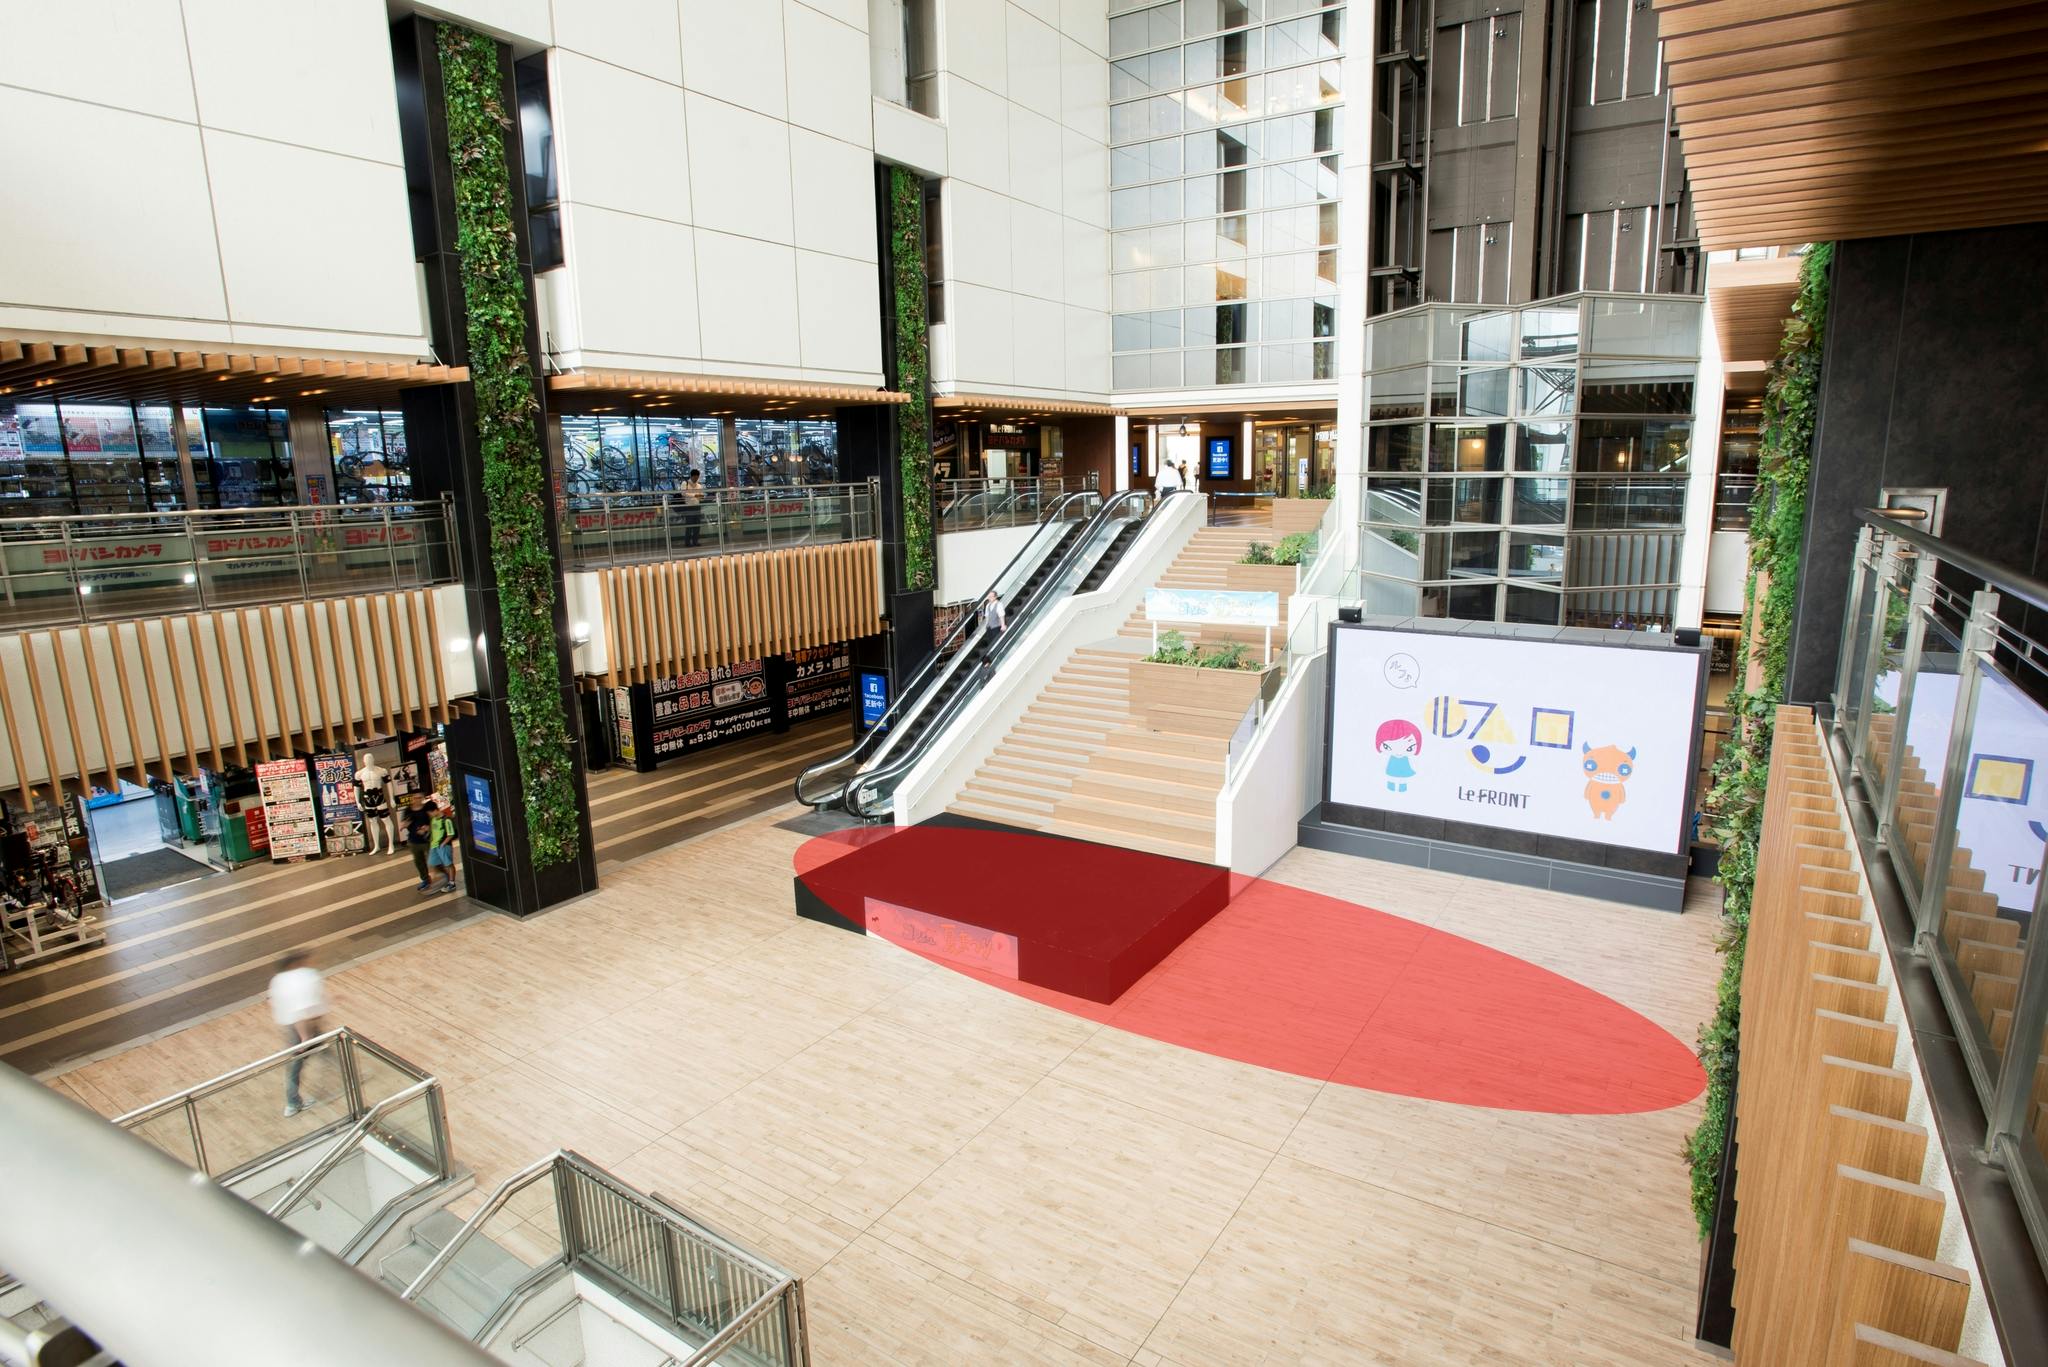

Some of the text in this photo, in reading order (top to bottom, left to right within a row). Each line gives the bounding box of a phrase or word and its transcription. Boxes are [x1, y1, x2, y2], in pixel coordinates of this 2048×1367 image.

[345, 526, 417, 545] ヨドバシ
[43, 543, 162, 564] ヨドバシカメラ
[653, 719, 711, 744] ヨドバシカメラ
[654, 738, 684, 755] 年中無休
